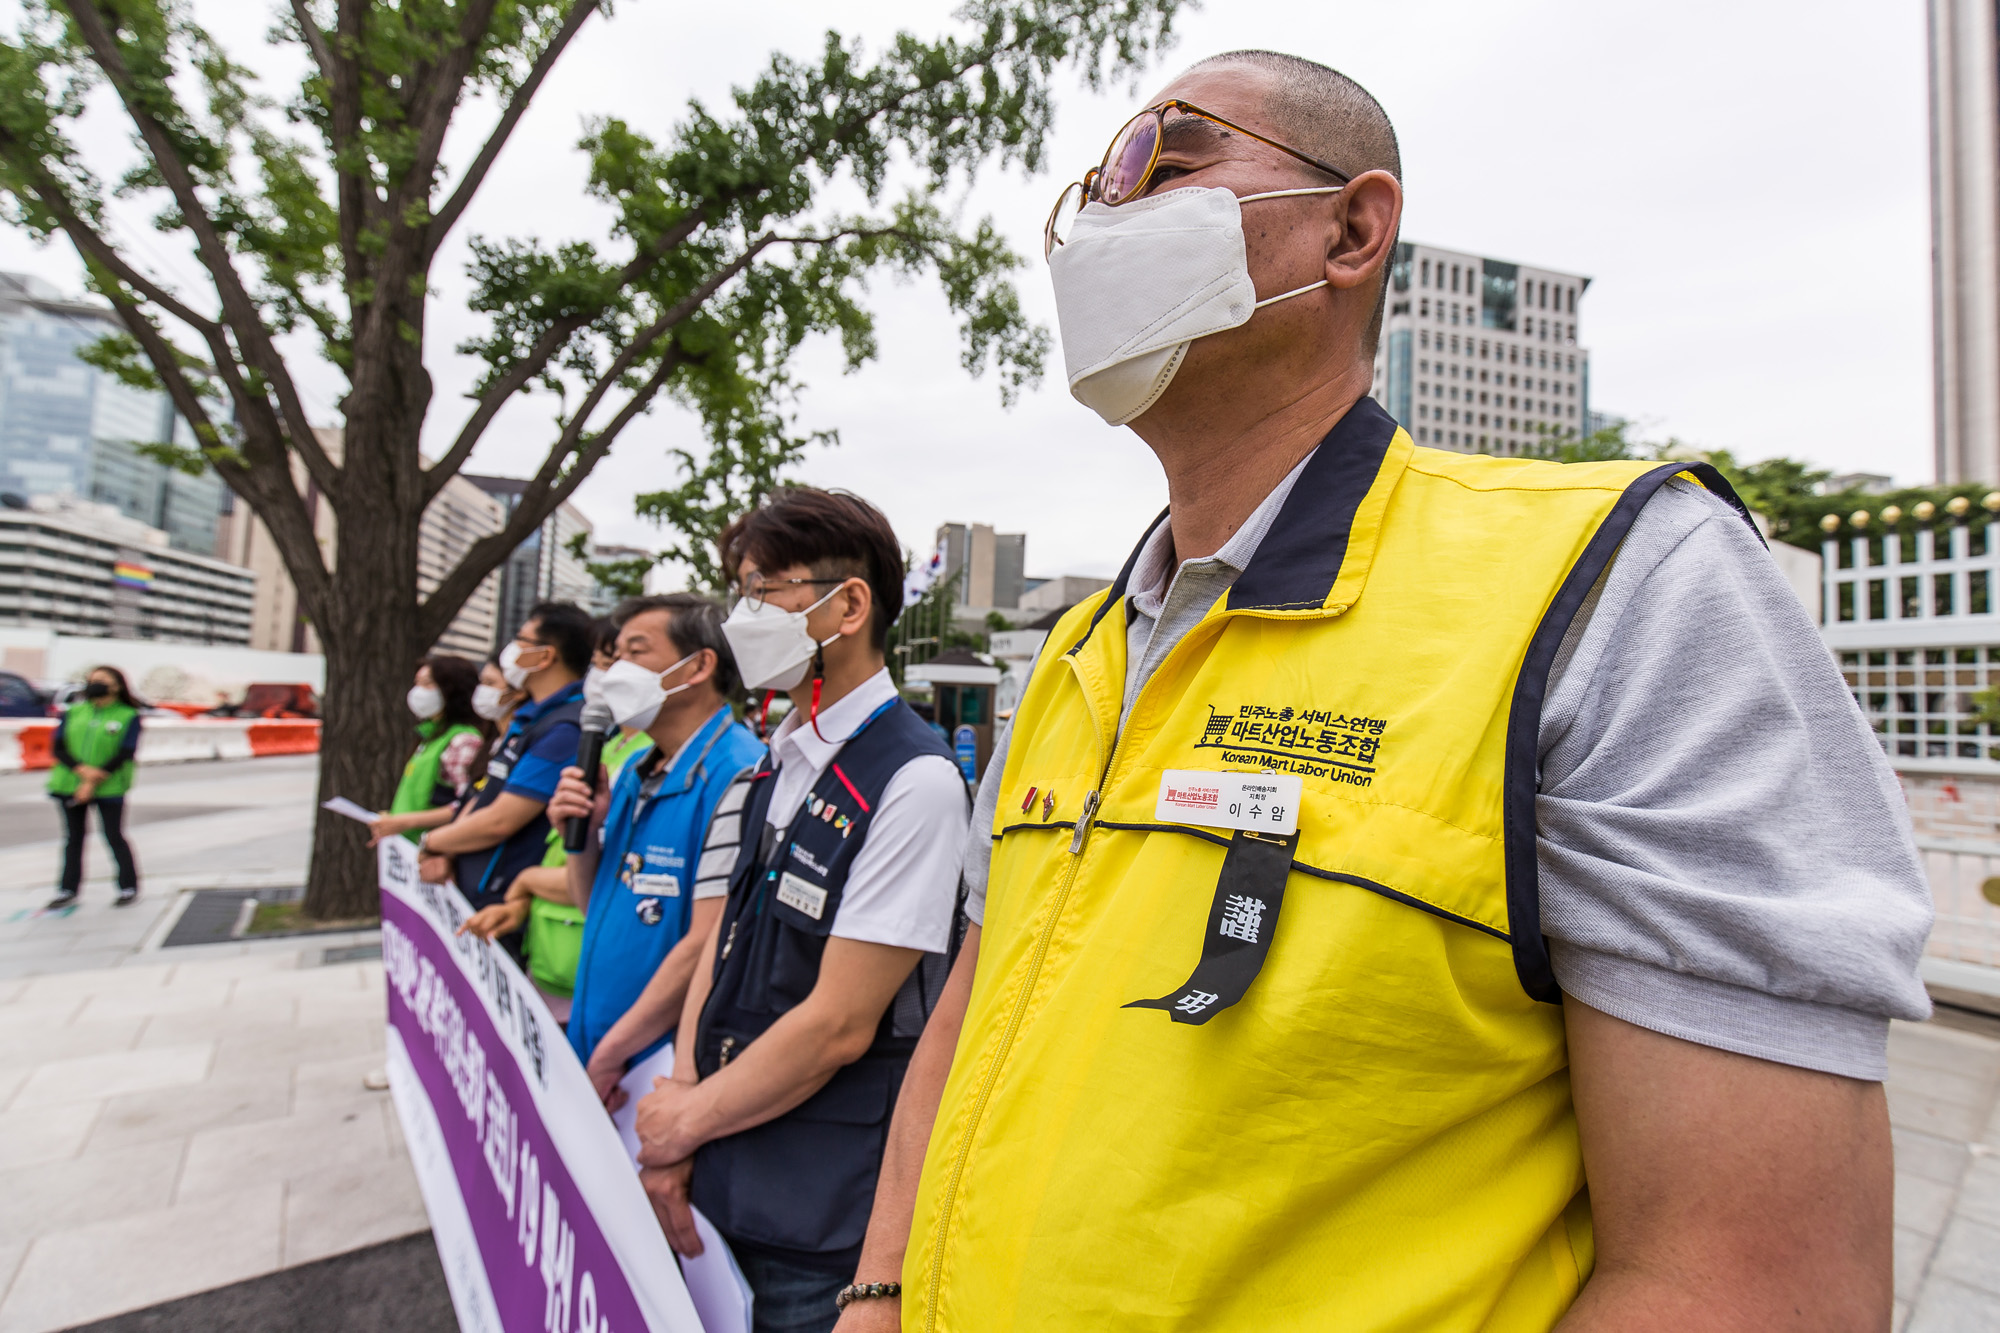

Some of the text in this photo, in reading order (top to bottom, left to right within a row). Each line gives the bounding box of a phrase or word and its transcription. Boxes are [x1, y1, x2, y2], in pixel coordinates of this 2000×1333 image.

[1239, 705, 1387, 735] 민주노총 서비스연맹
[1231, 720, 1381, 764] 마트산업노동조합
[1221, 751, 1372, 788] Korean Mart Labor Union
[1241, 784, 1277, 793] 온라인배송지회
[1249, 793, 1266, 801] 지회장
